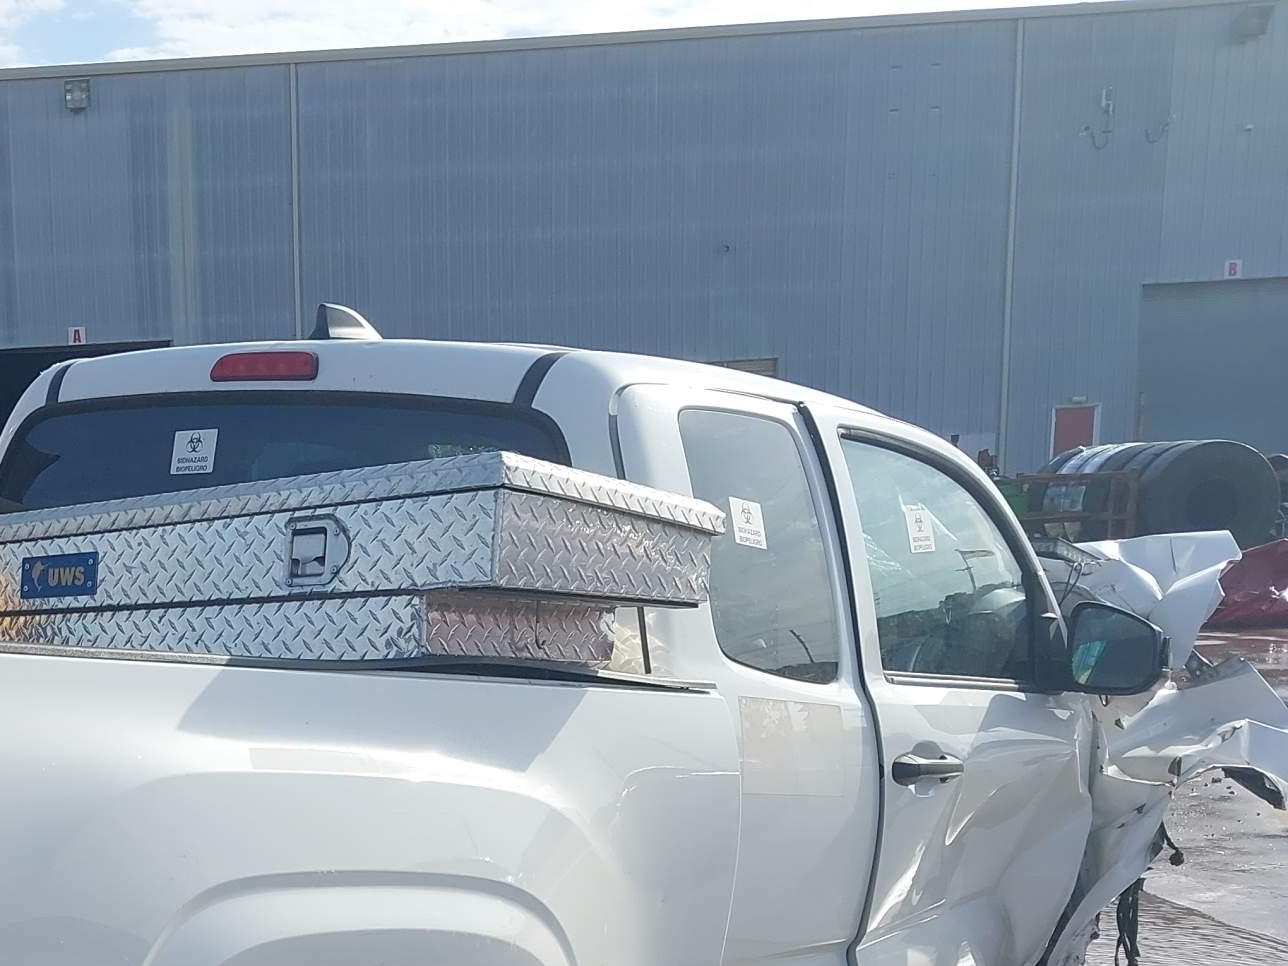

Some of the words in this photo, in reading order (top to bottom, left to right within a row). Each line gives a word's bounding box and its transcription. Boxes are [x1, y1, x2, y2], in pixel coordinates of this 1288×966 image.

[1228, 262, 1237, 277] B
[73, 329, 82, 344] A
[47, 566, 85, 587] UWS
